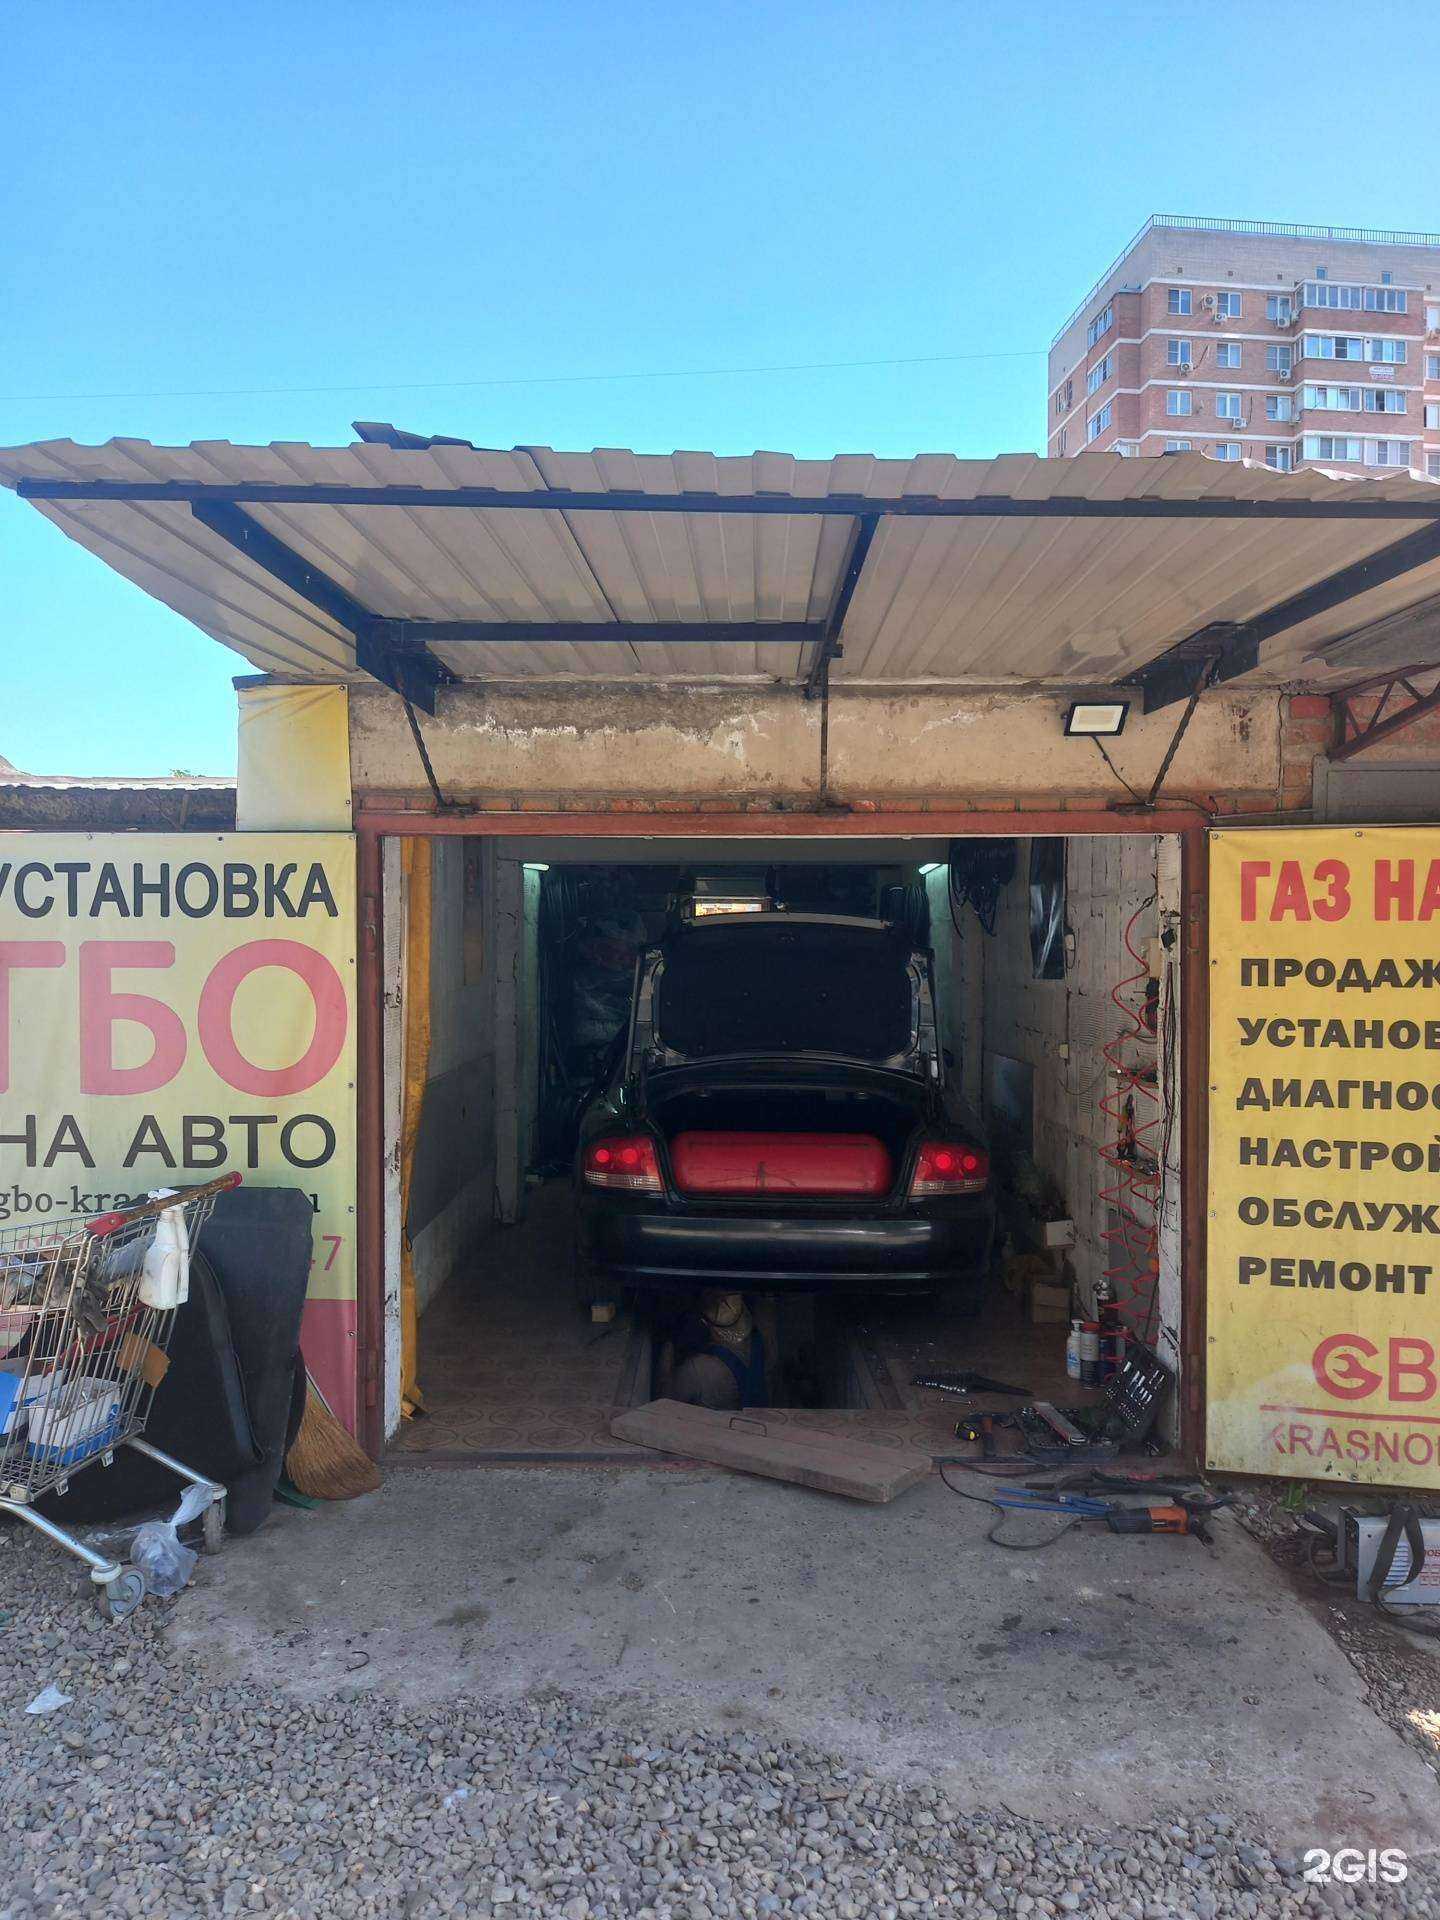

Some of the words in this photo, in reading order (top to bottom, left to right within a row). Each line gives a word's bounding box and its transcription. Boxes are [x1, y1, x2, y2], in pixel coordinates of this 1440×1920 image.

[1241, 859, 1351, 922] ГАЗ
[1241, 958, 1440, 993] ПРОДАЖ
[123, 1114, 336, 1169] АВТО
[1238, 1197, 1440, 1234] ОБСЛУЖ
[1238, 1256, 1432, 1294] РЕМОНТ
[1267, 1422, 1440, 1466] KRASNO
